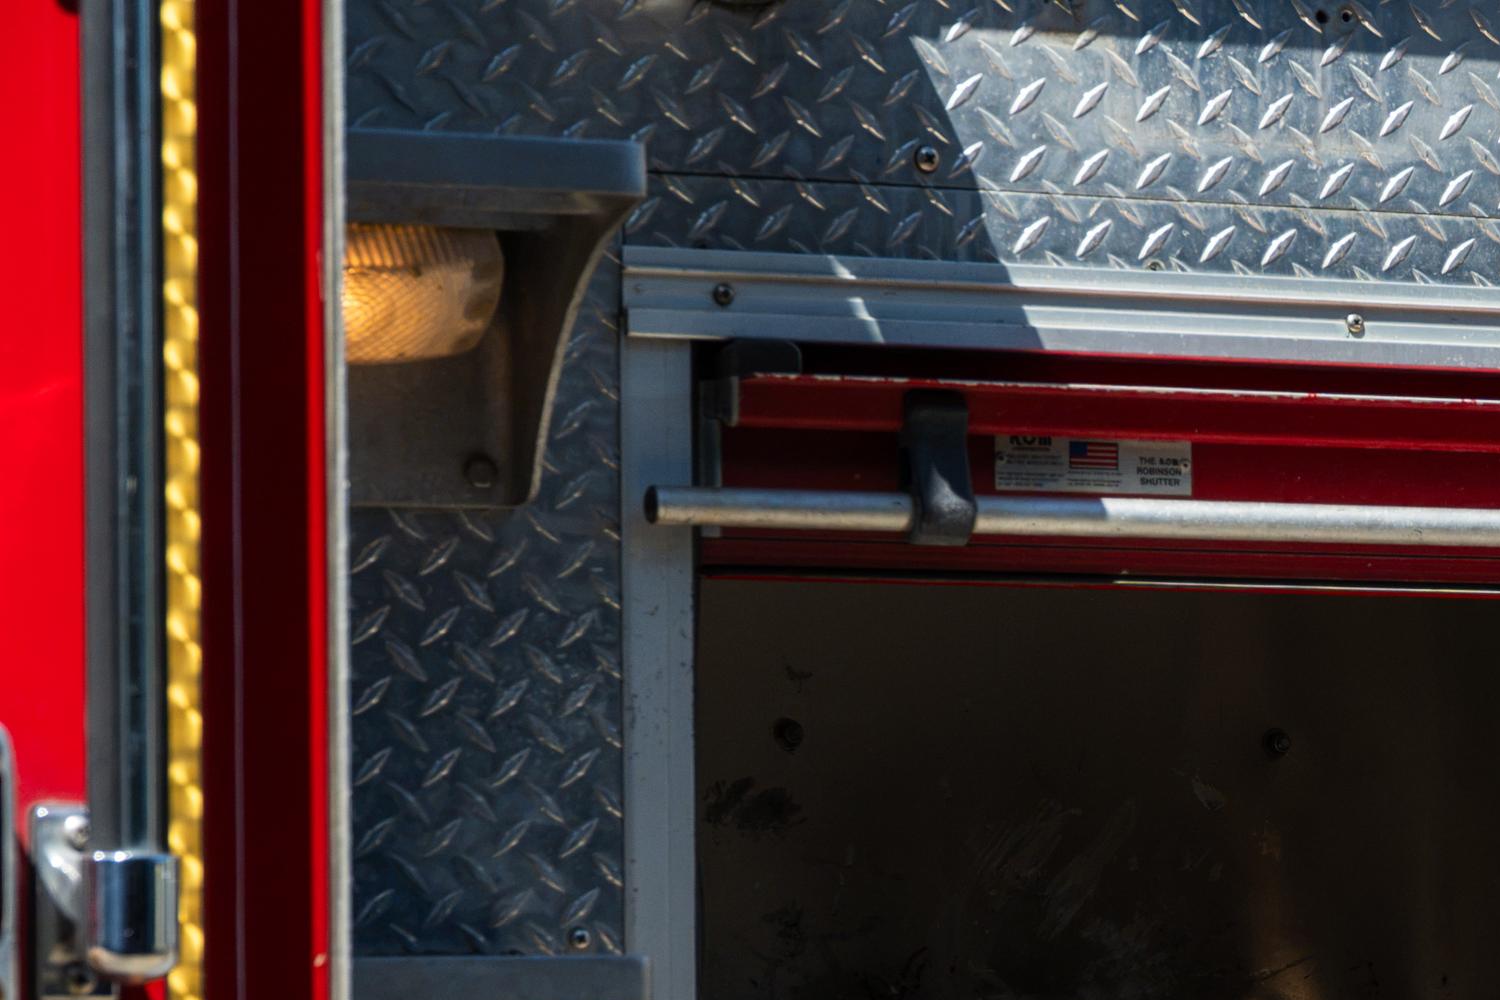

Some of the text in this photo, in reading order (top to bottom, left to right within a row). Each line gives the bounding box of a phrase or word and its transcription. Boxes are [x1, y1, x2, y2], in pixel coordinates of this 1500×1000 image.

[1139, 456, 1156, 465] THE
[1136, 466, 1182, 476] ROBINSON
[1140, 477, 1181, 486] SHUTTER
